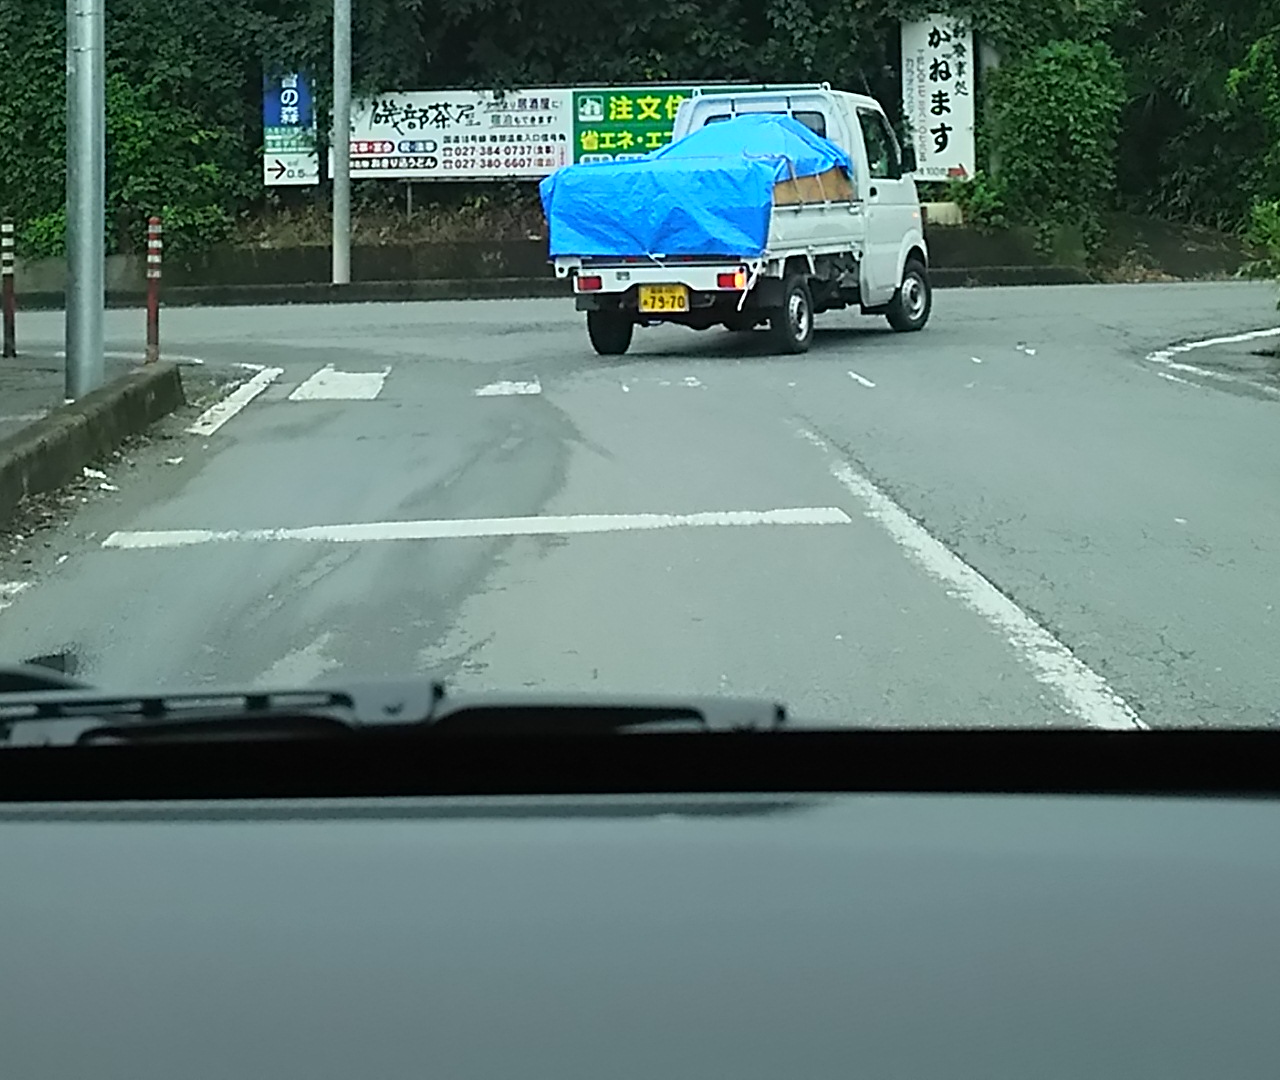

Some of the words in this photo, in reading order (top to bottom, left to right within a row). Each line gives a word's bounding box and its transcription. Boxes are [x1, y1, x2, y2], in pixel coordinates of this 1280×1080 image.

[370, 98, 482, 136] 磯部茶屋
[928, 26, 953, 154] かねます
